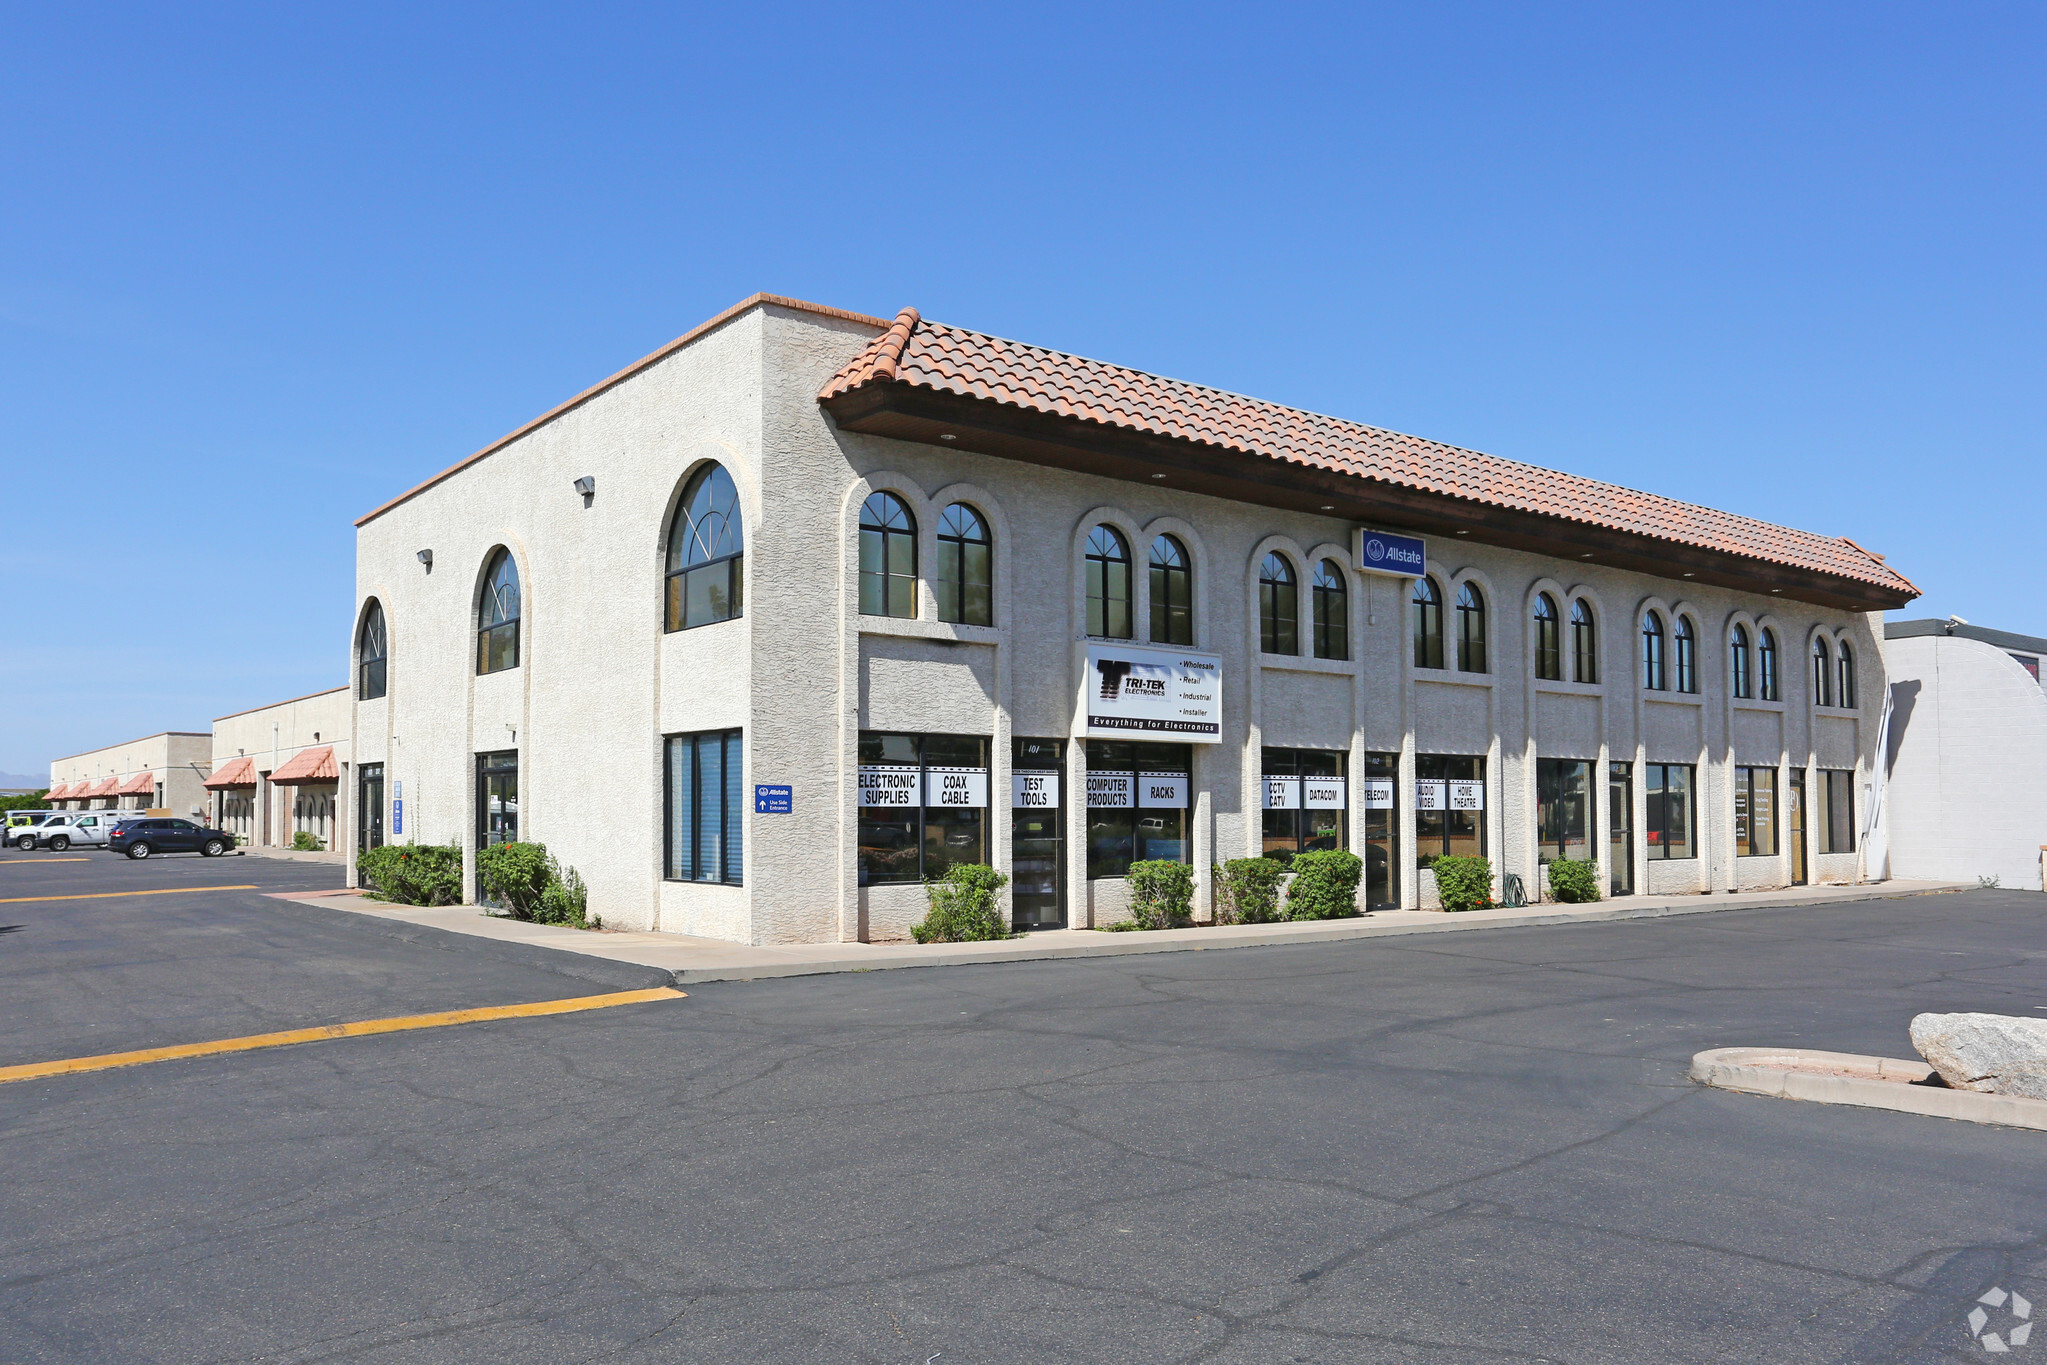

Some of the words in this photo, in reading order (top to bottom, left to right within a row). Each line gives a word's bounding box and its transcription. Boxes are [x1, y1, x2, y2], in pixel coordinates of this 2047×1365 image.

[1386, 547, 1421, 564] Allstate
[1184, 660, 1214, 670] Wholesale
[1126, 678, 1165, 690] TRI-TEK
[1183, 676, 1200, 684] Retail
[1125, 688, 1165, 696] ELECTRONICS
[1183, 692, 1212, 701] Industrial
[1183, 708, 1208, 716] Installer
[1094, 718, 1143, 728] Everything
[1164, 722, 1214, 732] Electronics
[1028, 744, 1040, 754] 101
[858, 774, 916, 788] ELECTRONIC
[944, 776, 967, 789] COAX
[1024, 778, 1044, 790] TEST
[1087, 779, 1128, 792] COMPUTER
[1150, 786, 1174, 799] RACKS
[1269, 783, 1285, 794] CCTV
[1418, 786, 1435, 796] AUDIO
[1458, 786, 1472, 796] HOME
[865, 790, 909, 804] SUPPLIES
[942, 791, 969, 804] CABLE
[1021, 793, 1047, 805] TOOLS
[1088, 794, 1127, 806] PRODUCTS
[1310, 790, 1337, 800] DATACOM
[1365, 790, 1389, 801] TELECOM
[1269, 796, 1285, 807] CATV
[1419, 798, 1434, 808] VIDEO
[1454, 798, 1476, 808] THEATRE
